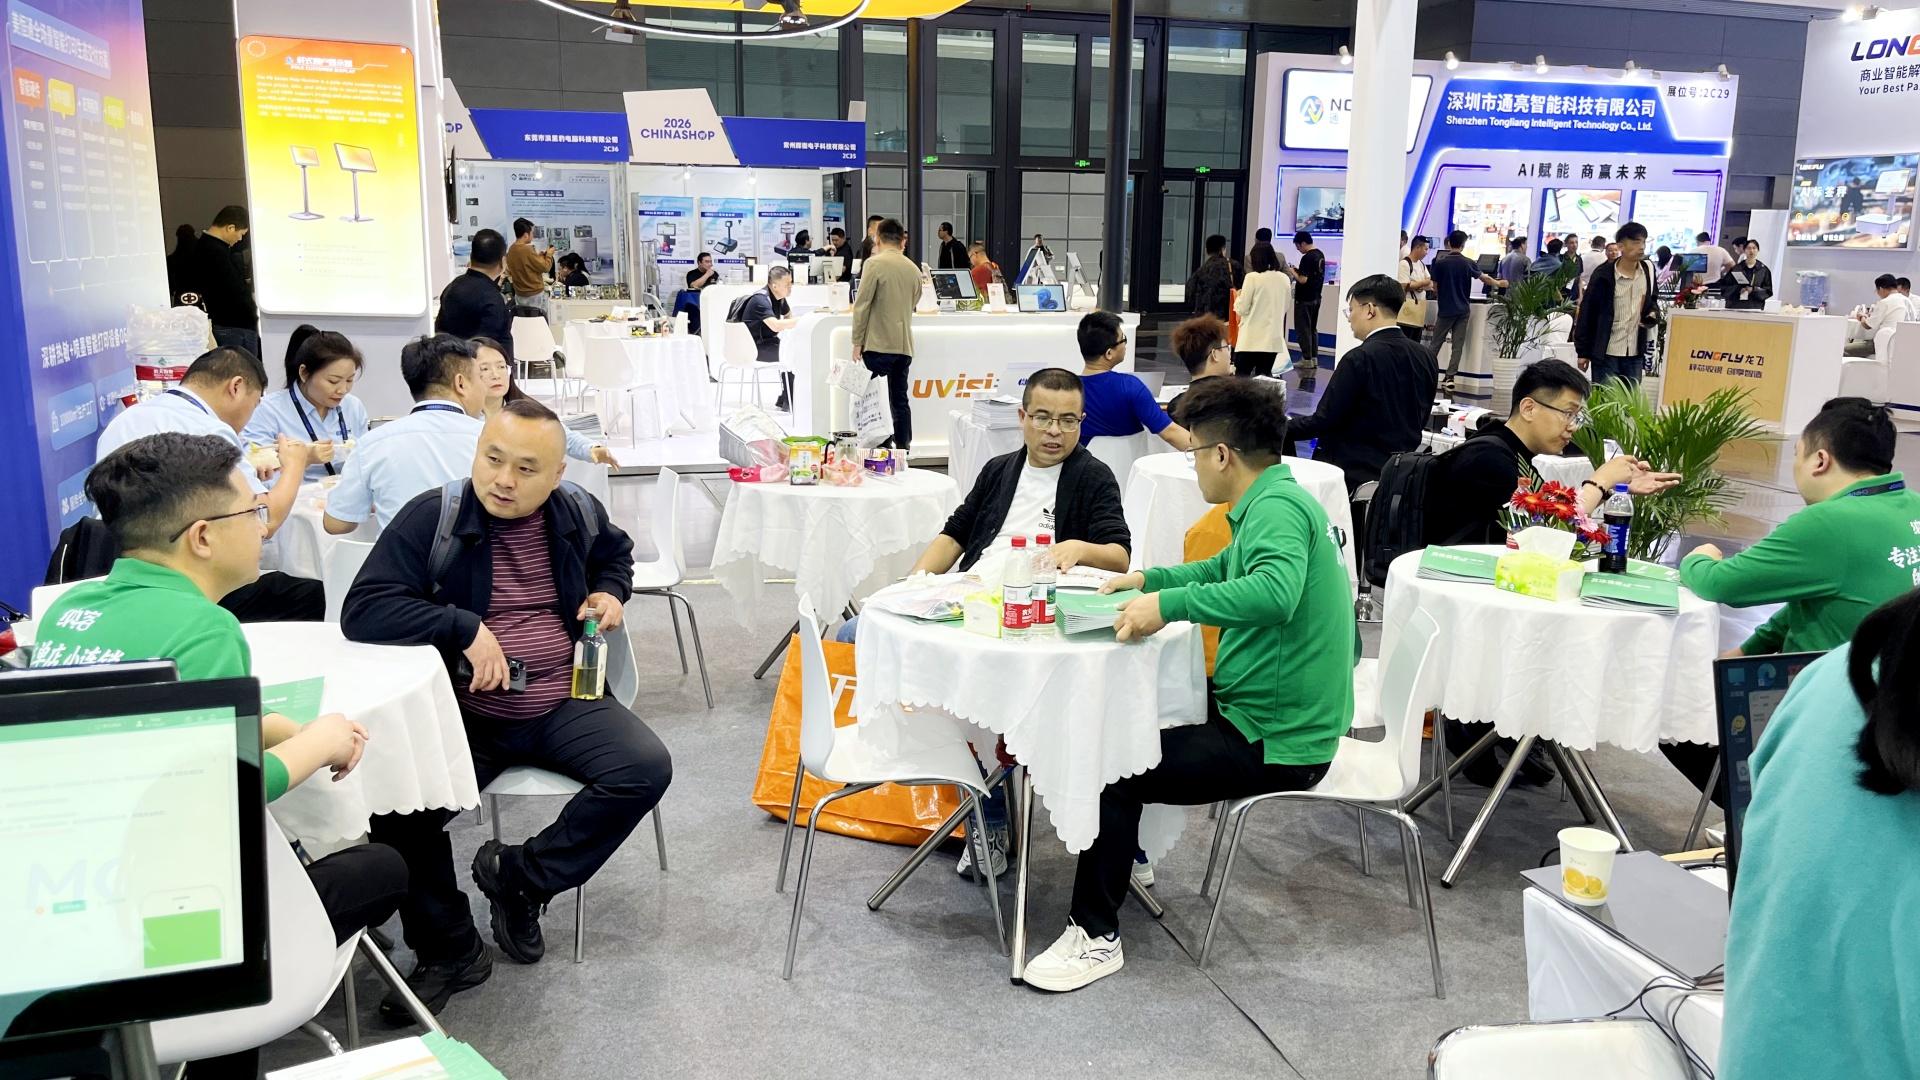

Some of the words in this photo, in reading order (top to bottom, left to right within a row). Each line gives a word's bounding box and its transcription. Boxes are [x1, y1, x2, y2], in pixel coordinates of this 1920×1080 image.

[1859, 86, 1880, 95] Your
[1883, 84, 1904, 93] Best
[1447, 91, 1656, 118] 深圳市通亮智能科技有限公司
[664, 118, 692, 128] 2026
[1446, 115, 1488, 127] Shenzhen
[1489, 117, 1530, 130] Tongliang
[1531, 118, 1572, 130] Intelligent
[1573, 120, 1619, 132] Technology
[1637, 122, 1652, 131] Ltd.
[640, 128, 715, 140] CHINASHOP
[1581, 164, 1647, 180] 商赢未来
[1690, 349, 1744, 363] LONGFLY
[1745, 354, 1765, 366] 龙飞
